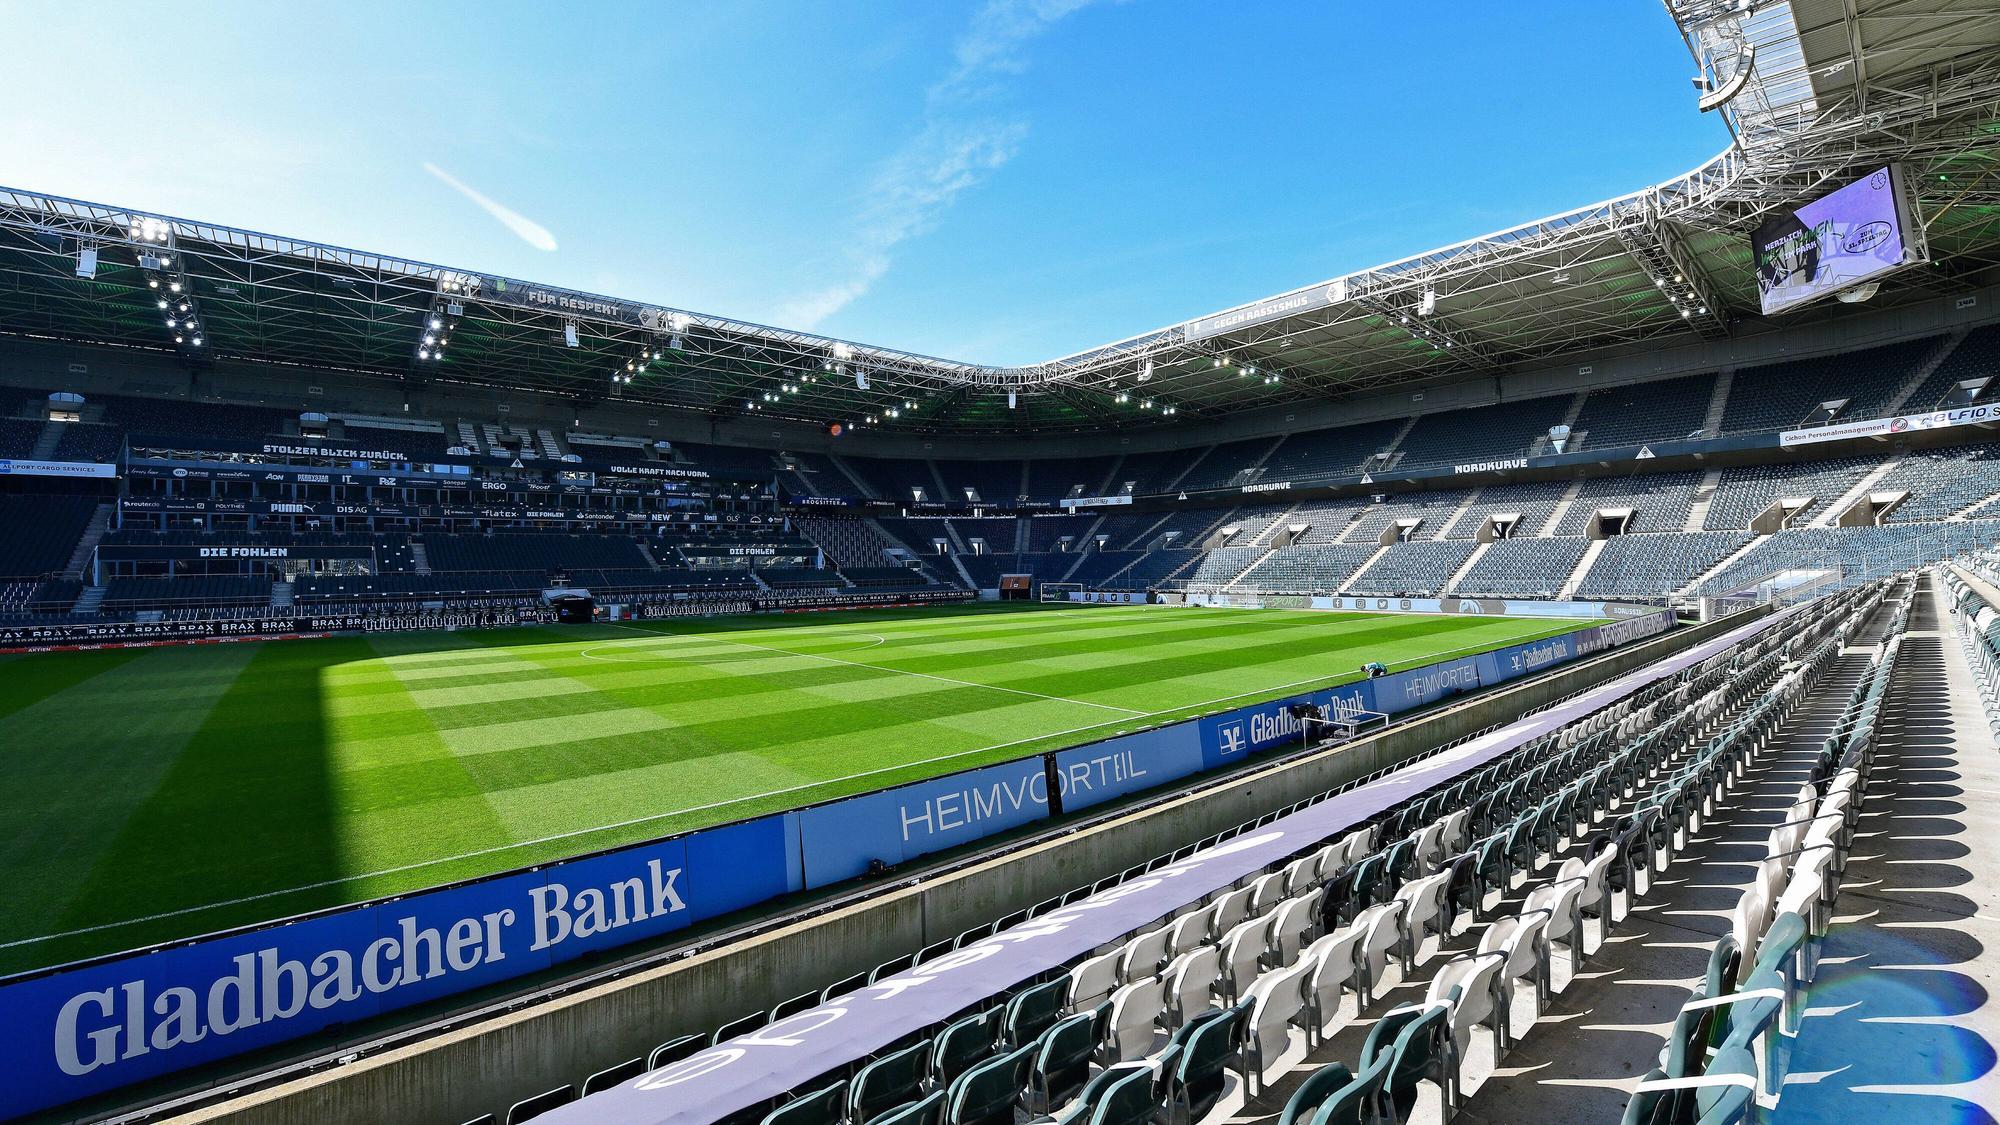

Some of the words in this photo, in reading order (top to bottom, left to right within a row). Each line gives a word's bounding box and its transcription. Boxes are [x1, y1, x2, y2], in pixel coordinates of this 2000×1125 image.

[1764, 229, 1802, 252] HERZLICH
[528, 291, 557, 305] FÜR
[559, 297, 619, 316] RESPEKT
[1214, 312, 1245, 329] GEGEN
[1246, 296, 1308, 321] RASSISMUS
[1808, 423, 1886, 439] Personalmanagement
[263, 445, 318, 456] STOLZER
[320, 448, 358, 458] BLICK
[359, 450, 408, 461] ZURÜCK.
[610, 465, 637, 474] VOLLE
[638, 467, 665, 476] KRAFT
[665, 469, 686, 477] NACH
[1454, 458, 1528, 474] NORDKURVE
[265, 472, 284, 481] AON
[482, 482, 507, 490] ERGO
[1242, 481, 1291, 494] NORDKURVE
[270, 503, 304, 513] PUMA
[355, 506, 368, 514] AG
[651, 513, 671, 521] NEW
[200, 547, 227, 557] DIE
[231, 547, 288, 557] FOHLEN
[221, 623, 255, 631] BRAX
[262, 621, 294, 629] BRAX
[312, 619, 343, 627] BRAX
[1522, 642, 1554, 669] Gladbacher
[1553, 639, 1568, 659] Bank
[1404, 664, 1480, 700] HEIMVORTEIL
[1250, 700, 1331, 746] Gladbaer
[1330, 690, 1365, 722] Bank
[900, 750, 1147, 841] HEIMVORTEIL
[53, 908, 515, 1077] Gladbacher
[528, 857, 687, 953] Bank
